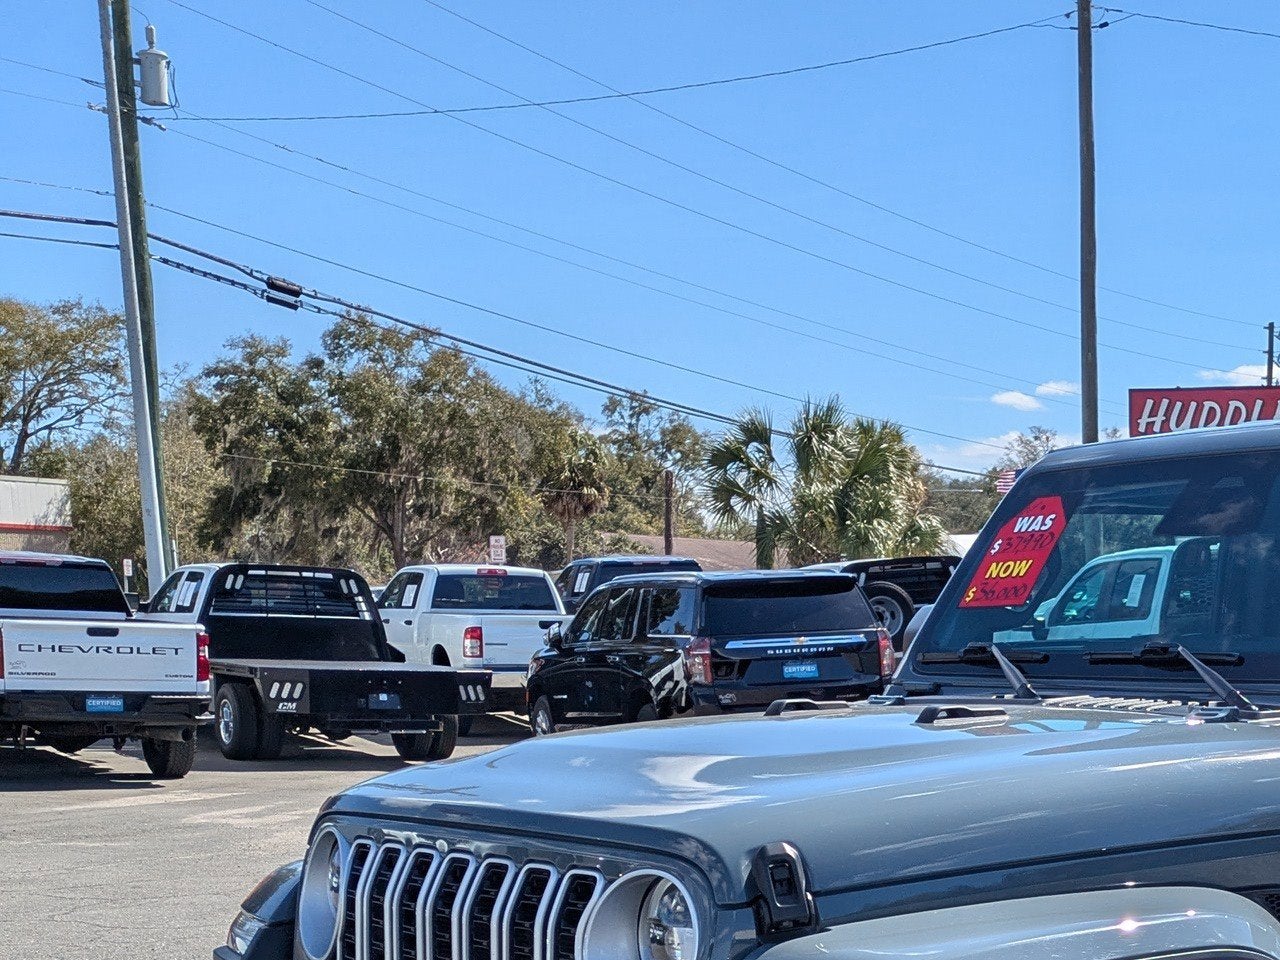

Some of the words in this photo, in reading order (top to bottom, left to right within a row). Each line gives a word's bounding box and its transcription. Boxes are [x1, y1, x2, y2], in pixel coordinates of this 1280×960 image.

[1013, 513, 1056, 533] WAS
[984, 559, 1034, 579] NOW
[17, 643, 184, 656] CHEVROLET
[784, 665, 816, 674] CERTIFIED
